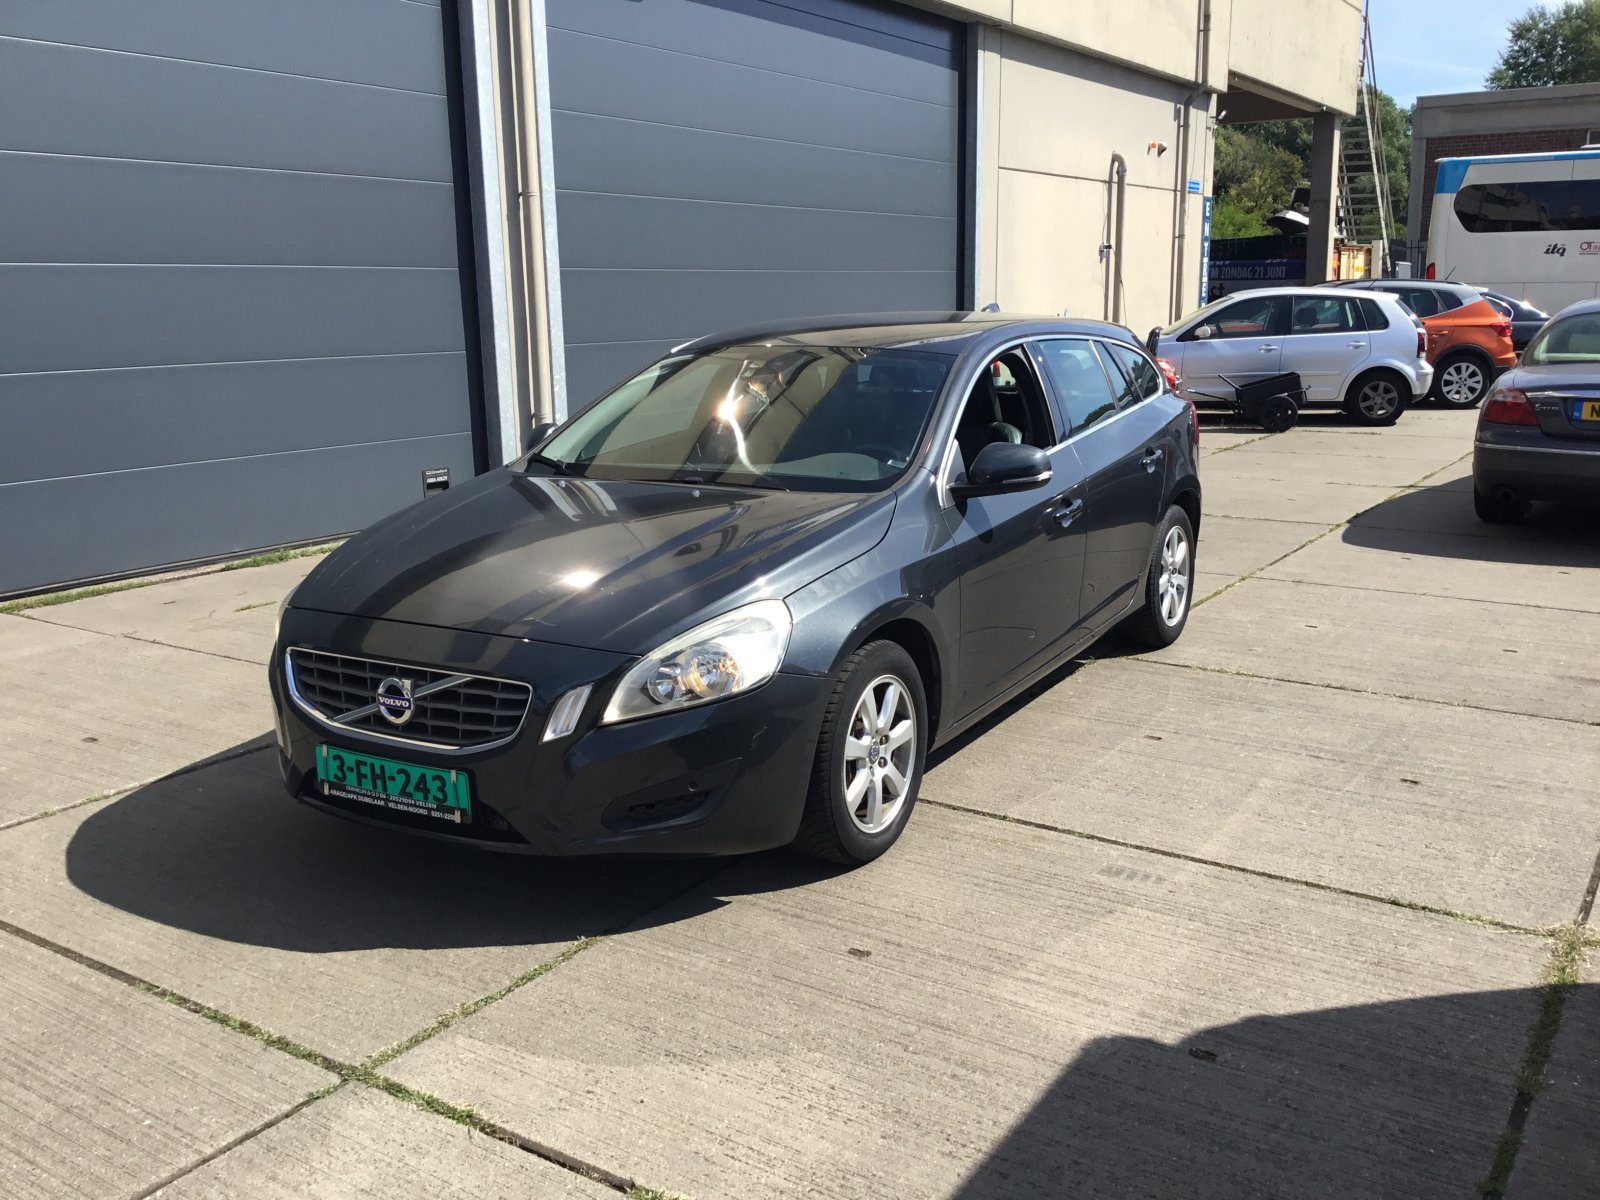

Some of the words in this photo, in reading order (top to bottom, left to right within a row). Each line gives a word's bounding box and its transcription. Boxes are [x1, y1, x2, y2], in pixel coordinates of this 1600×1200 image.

[1221, 266, 1253, 279] ZONDAG
[1254, 266, 1264, 279] 21
[1266, 266, 1287, 278] JUNI
[378, 696, 410, 708] VOLVO
[332, 754, 448, 804] 3-FH-243
